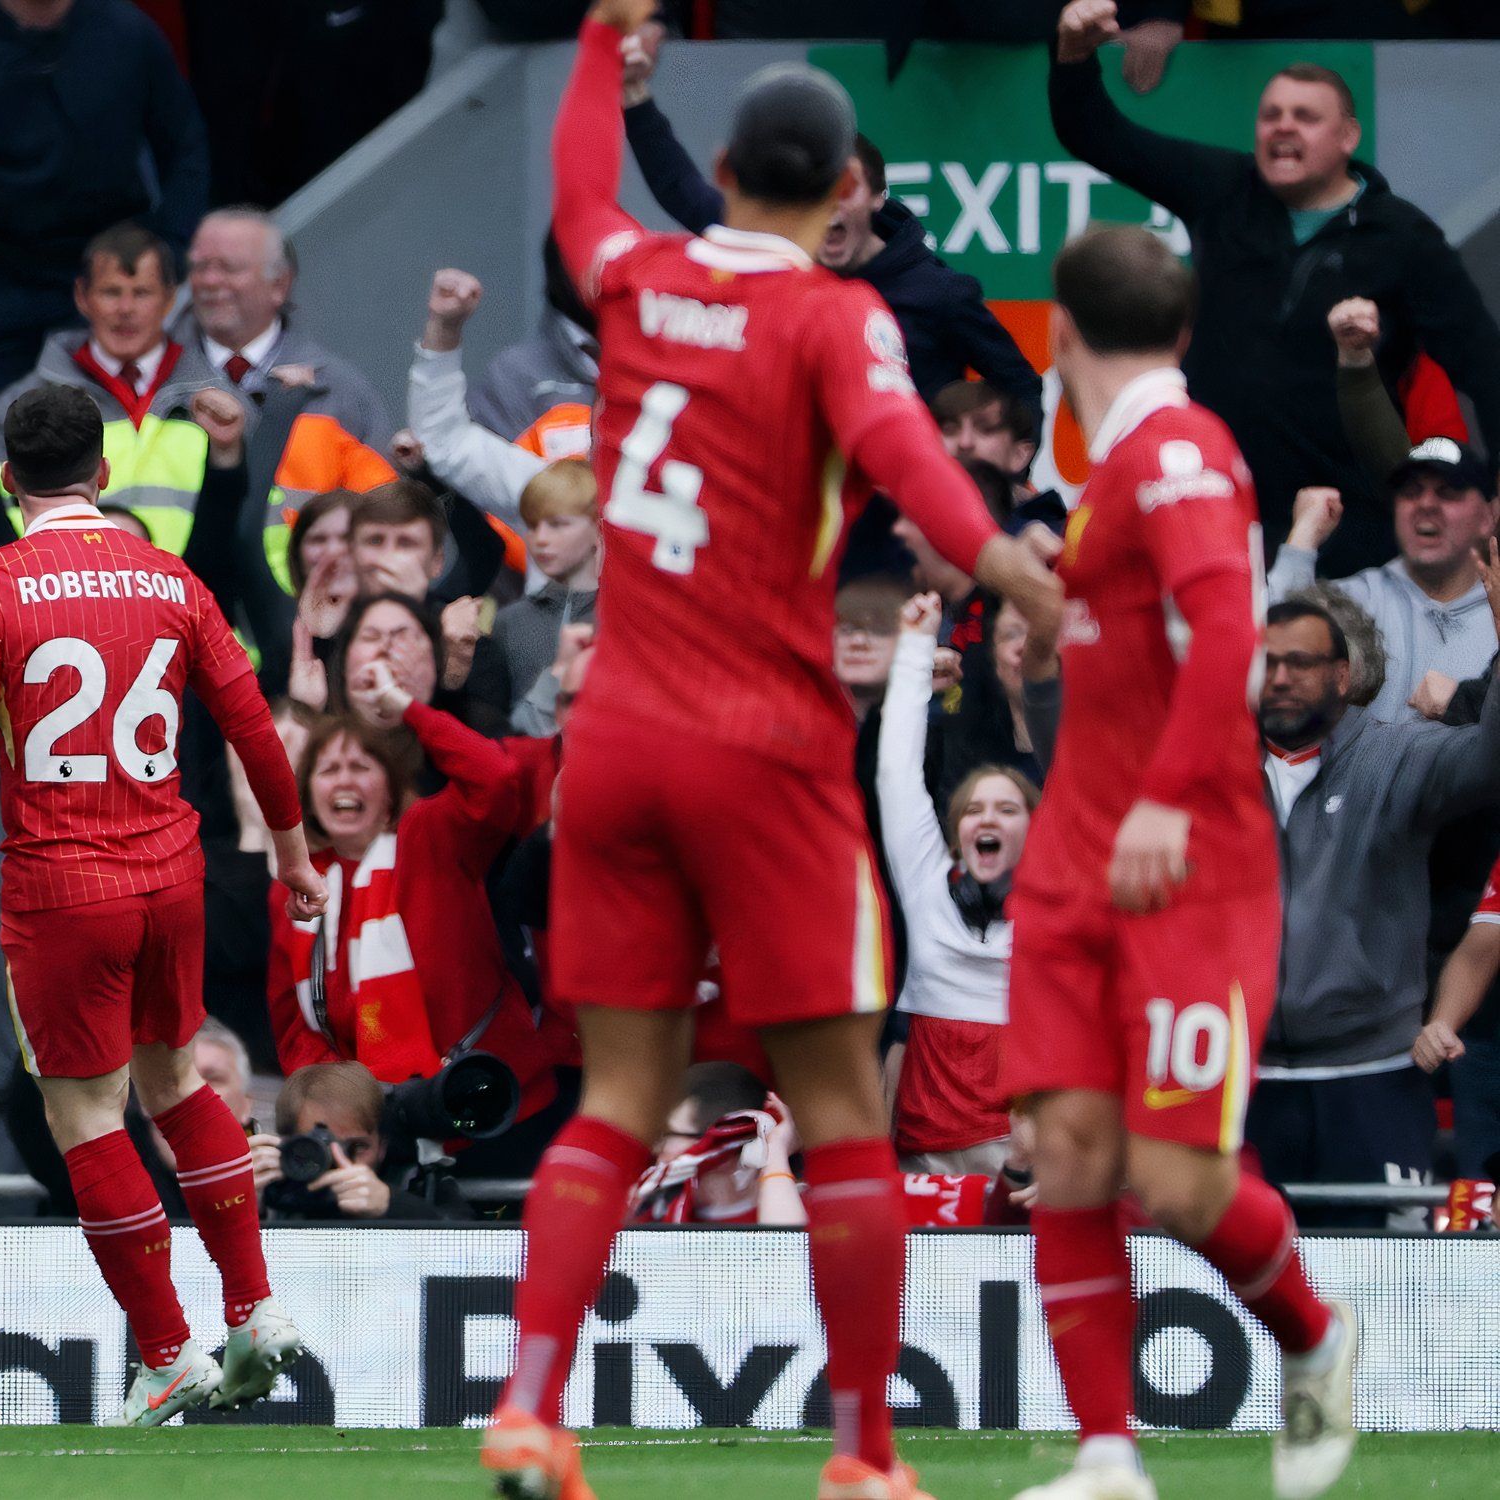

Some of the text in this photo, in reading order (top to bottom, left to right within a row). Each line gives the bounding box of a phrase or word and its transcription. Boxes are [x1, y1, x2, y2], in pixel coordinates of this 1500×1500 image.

[603, 380, 711, 575] 4
[17, 570, 187, 605] ROBERTSON
[23, 637, 180, 783] 26
[1145, 997, 1231, 1092] 10
